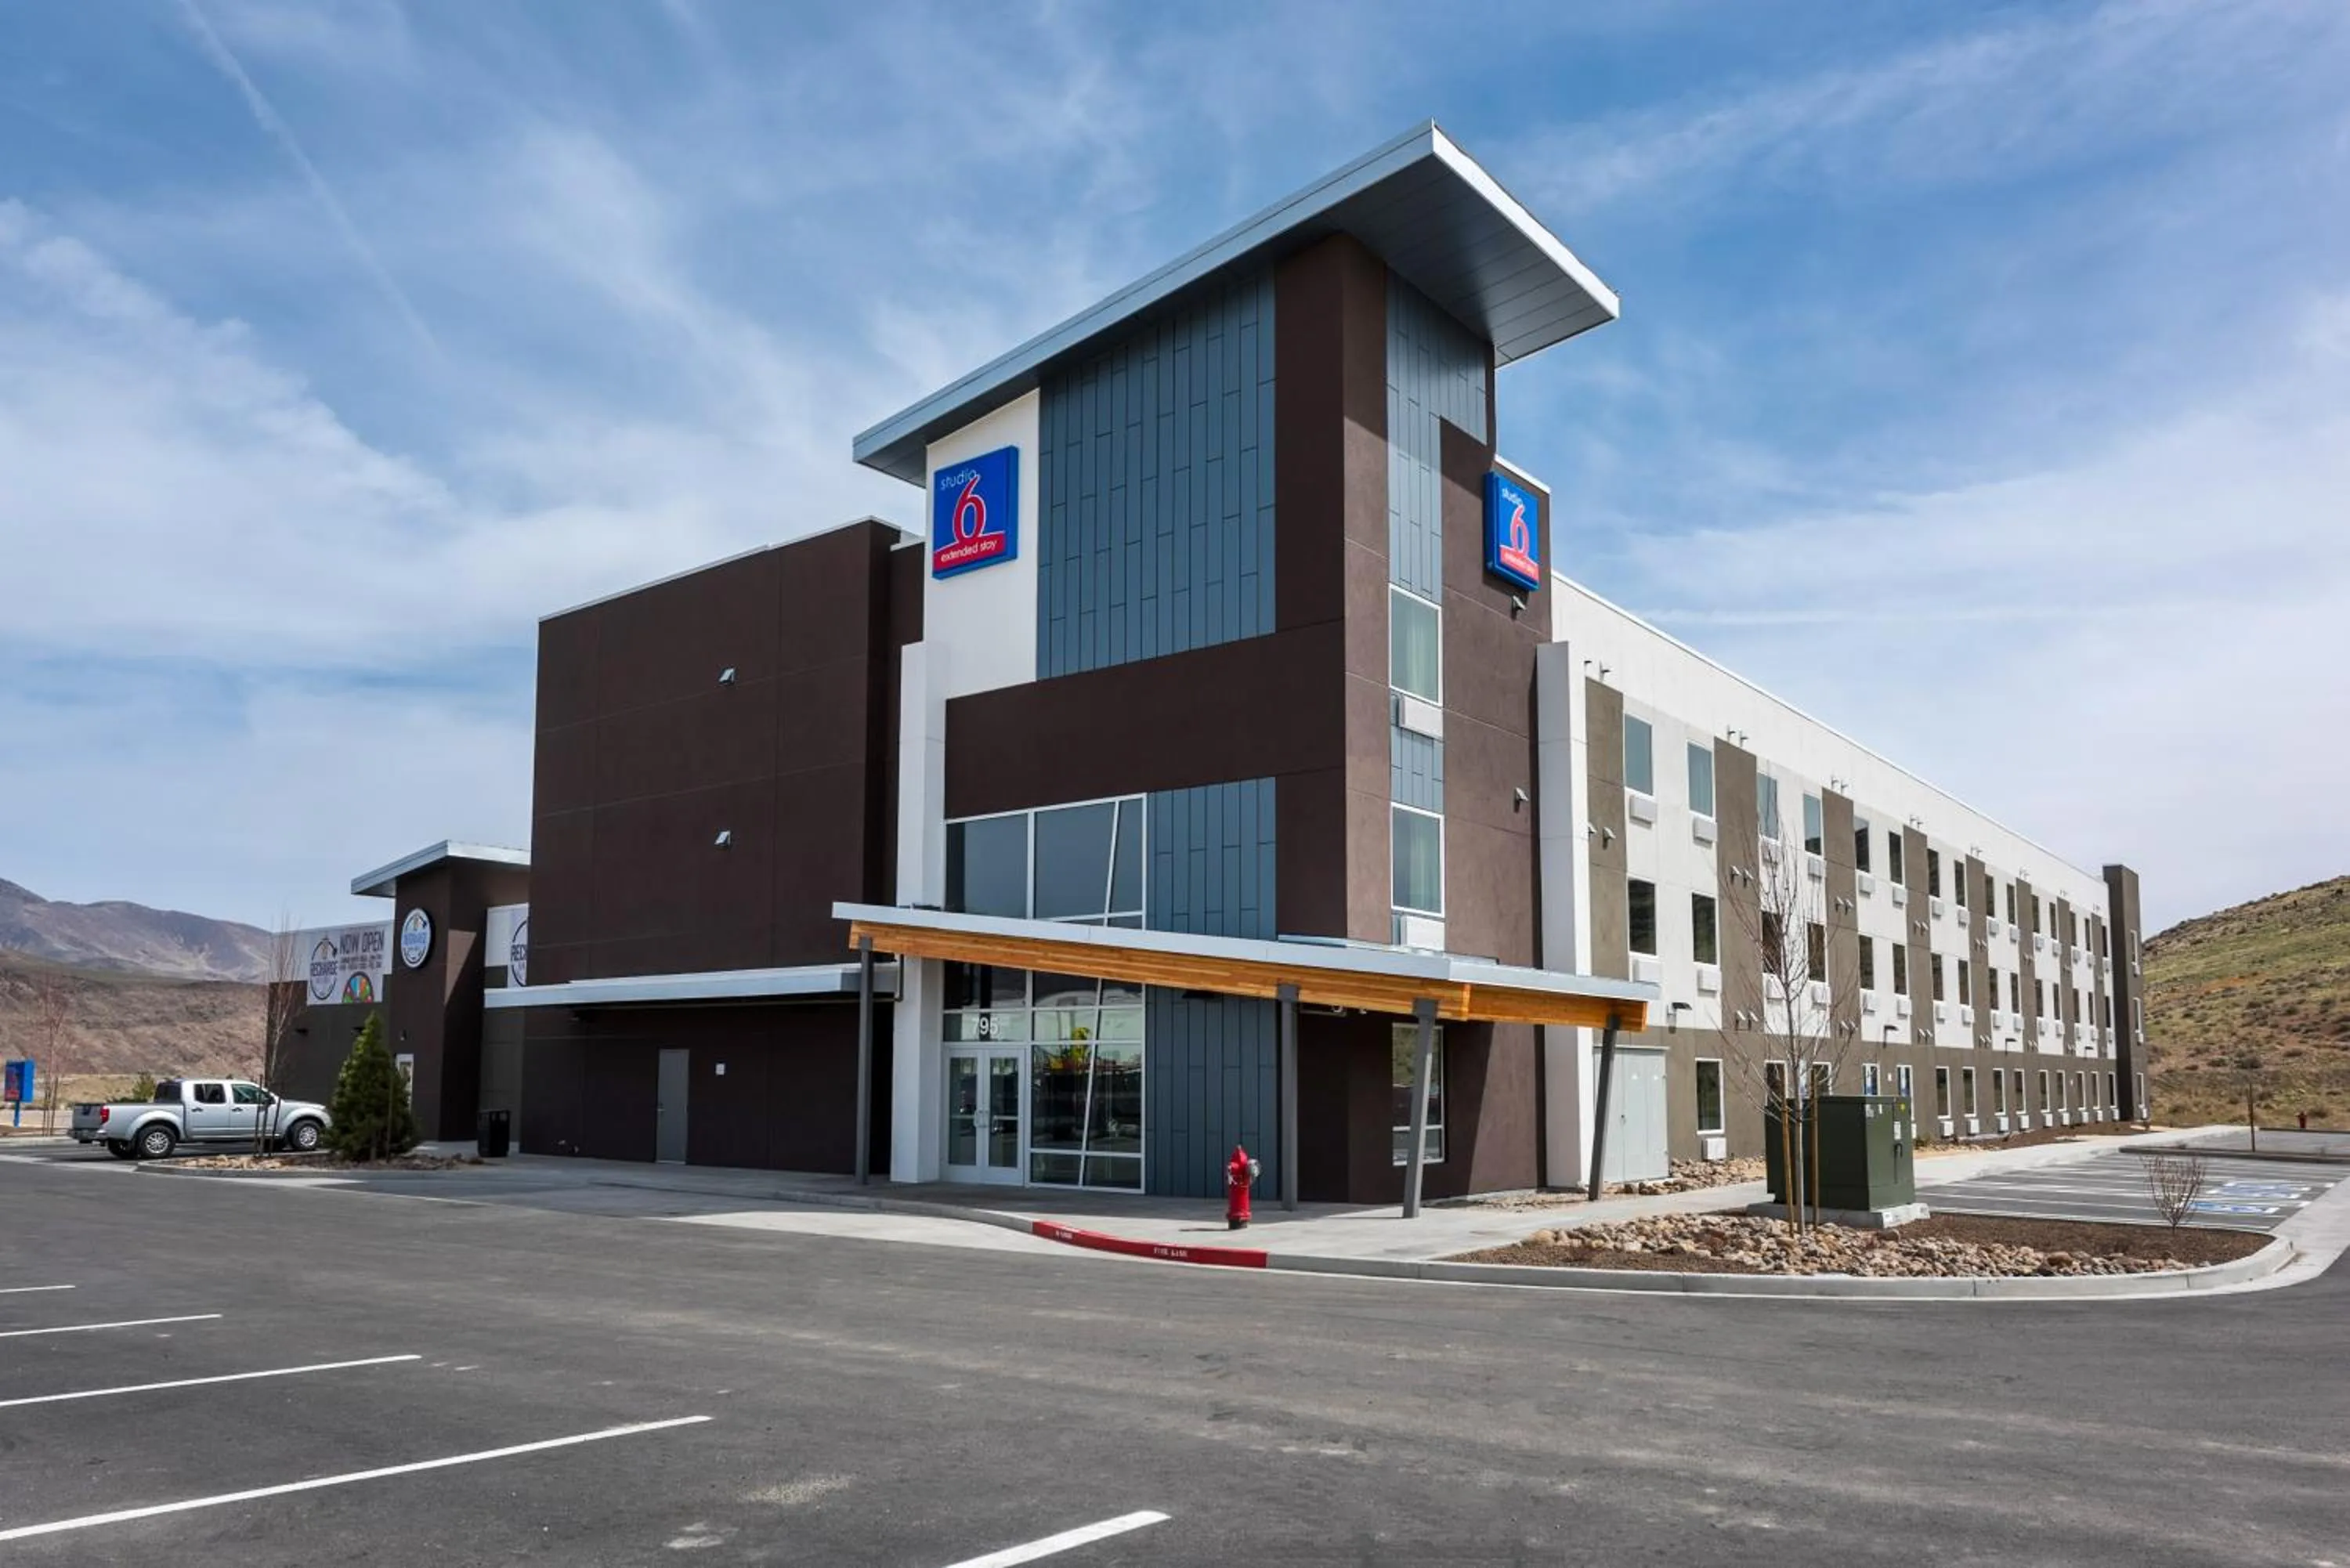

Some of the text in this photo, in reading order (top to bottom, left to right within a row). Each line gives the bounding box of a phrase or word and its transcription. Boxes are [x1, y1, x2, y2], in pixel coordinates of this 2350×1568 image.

[941, 468, 977, 490] studio
[952, 474, 987, 542] 6
[1510, 504, 1529, 555] 6
[940, 539, 998, 562] extended stay
[339, 929, 385, 956] NOW OPEN
[971, 1017, 999, 1035] 795
